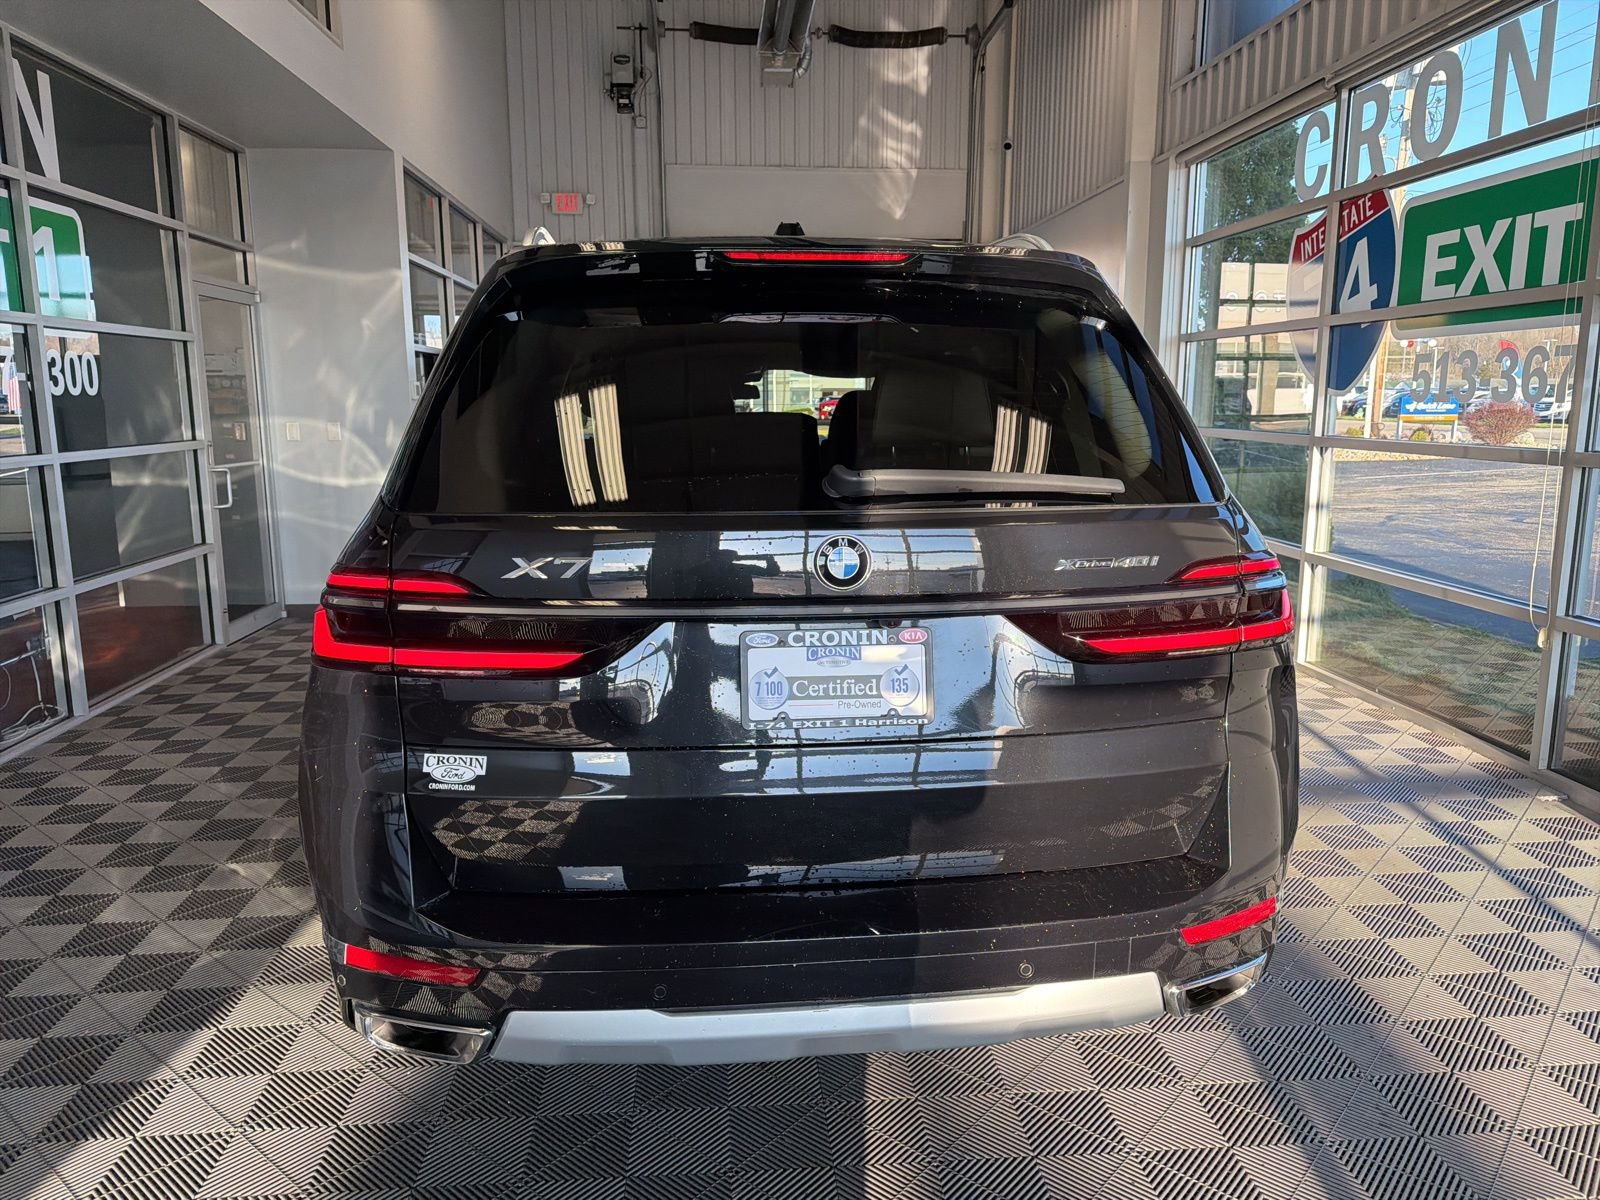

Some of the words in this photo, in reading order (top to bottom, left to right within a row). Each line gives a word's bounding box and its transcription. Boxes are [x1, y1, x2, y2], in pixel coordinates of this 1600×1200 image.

[1300, 193, 1374, 263] INTETATE
[1421, 202, 1584, 302] EXIT
[1409, 344, 1578, 403] 513-367
[823, 538, 865, 555] BMW
[500, 557, 592, 579] X7
[788, 629, 888, 647] CRONIN
[904, 632, 923, 640] KIA
[808, 647, 860, 660] CRONIN
[765, 681, 783, 696] 100
[792, 679, 878, 697] Certified
[890, 678, 909, 694] 135
[838, 700, 882, 709] Pre-Owned
[748, 721, 787, 730] I-74
[792, 720, 834, 728] EXIT
[839, 719, 849, 727] 1
[855, 718, 929, 726] Harrison
[425, 755, 485, 771] CRONIN
[441, 767, 466, 780] Ford
[428, 782, 476, 791] CRONINFORD.COM
